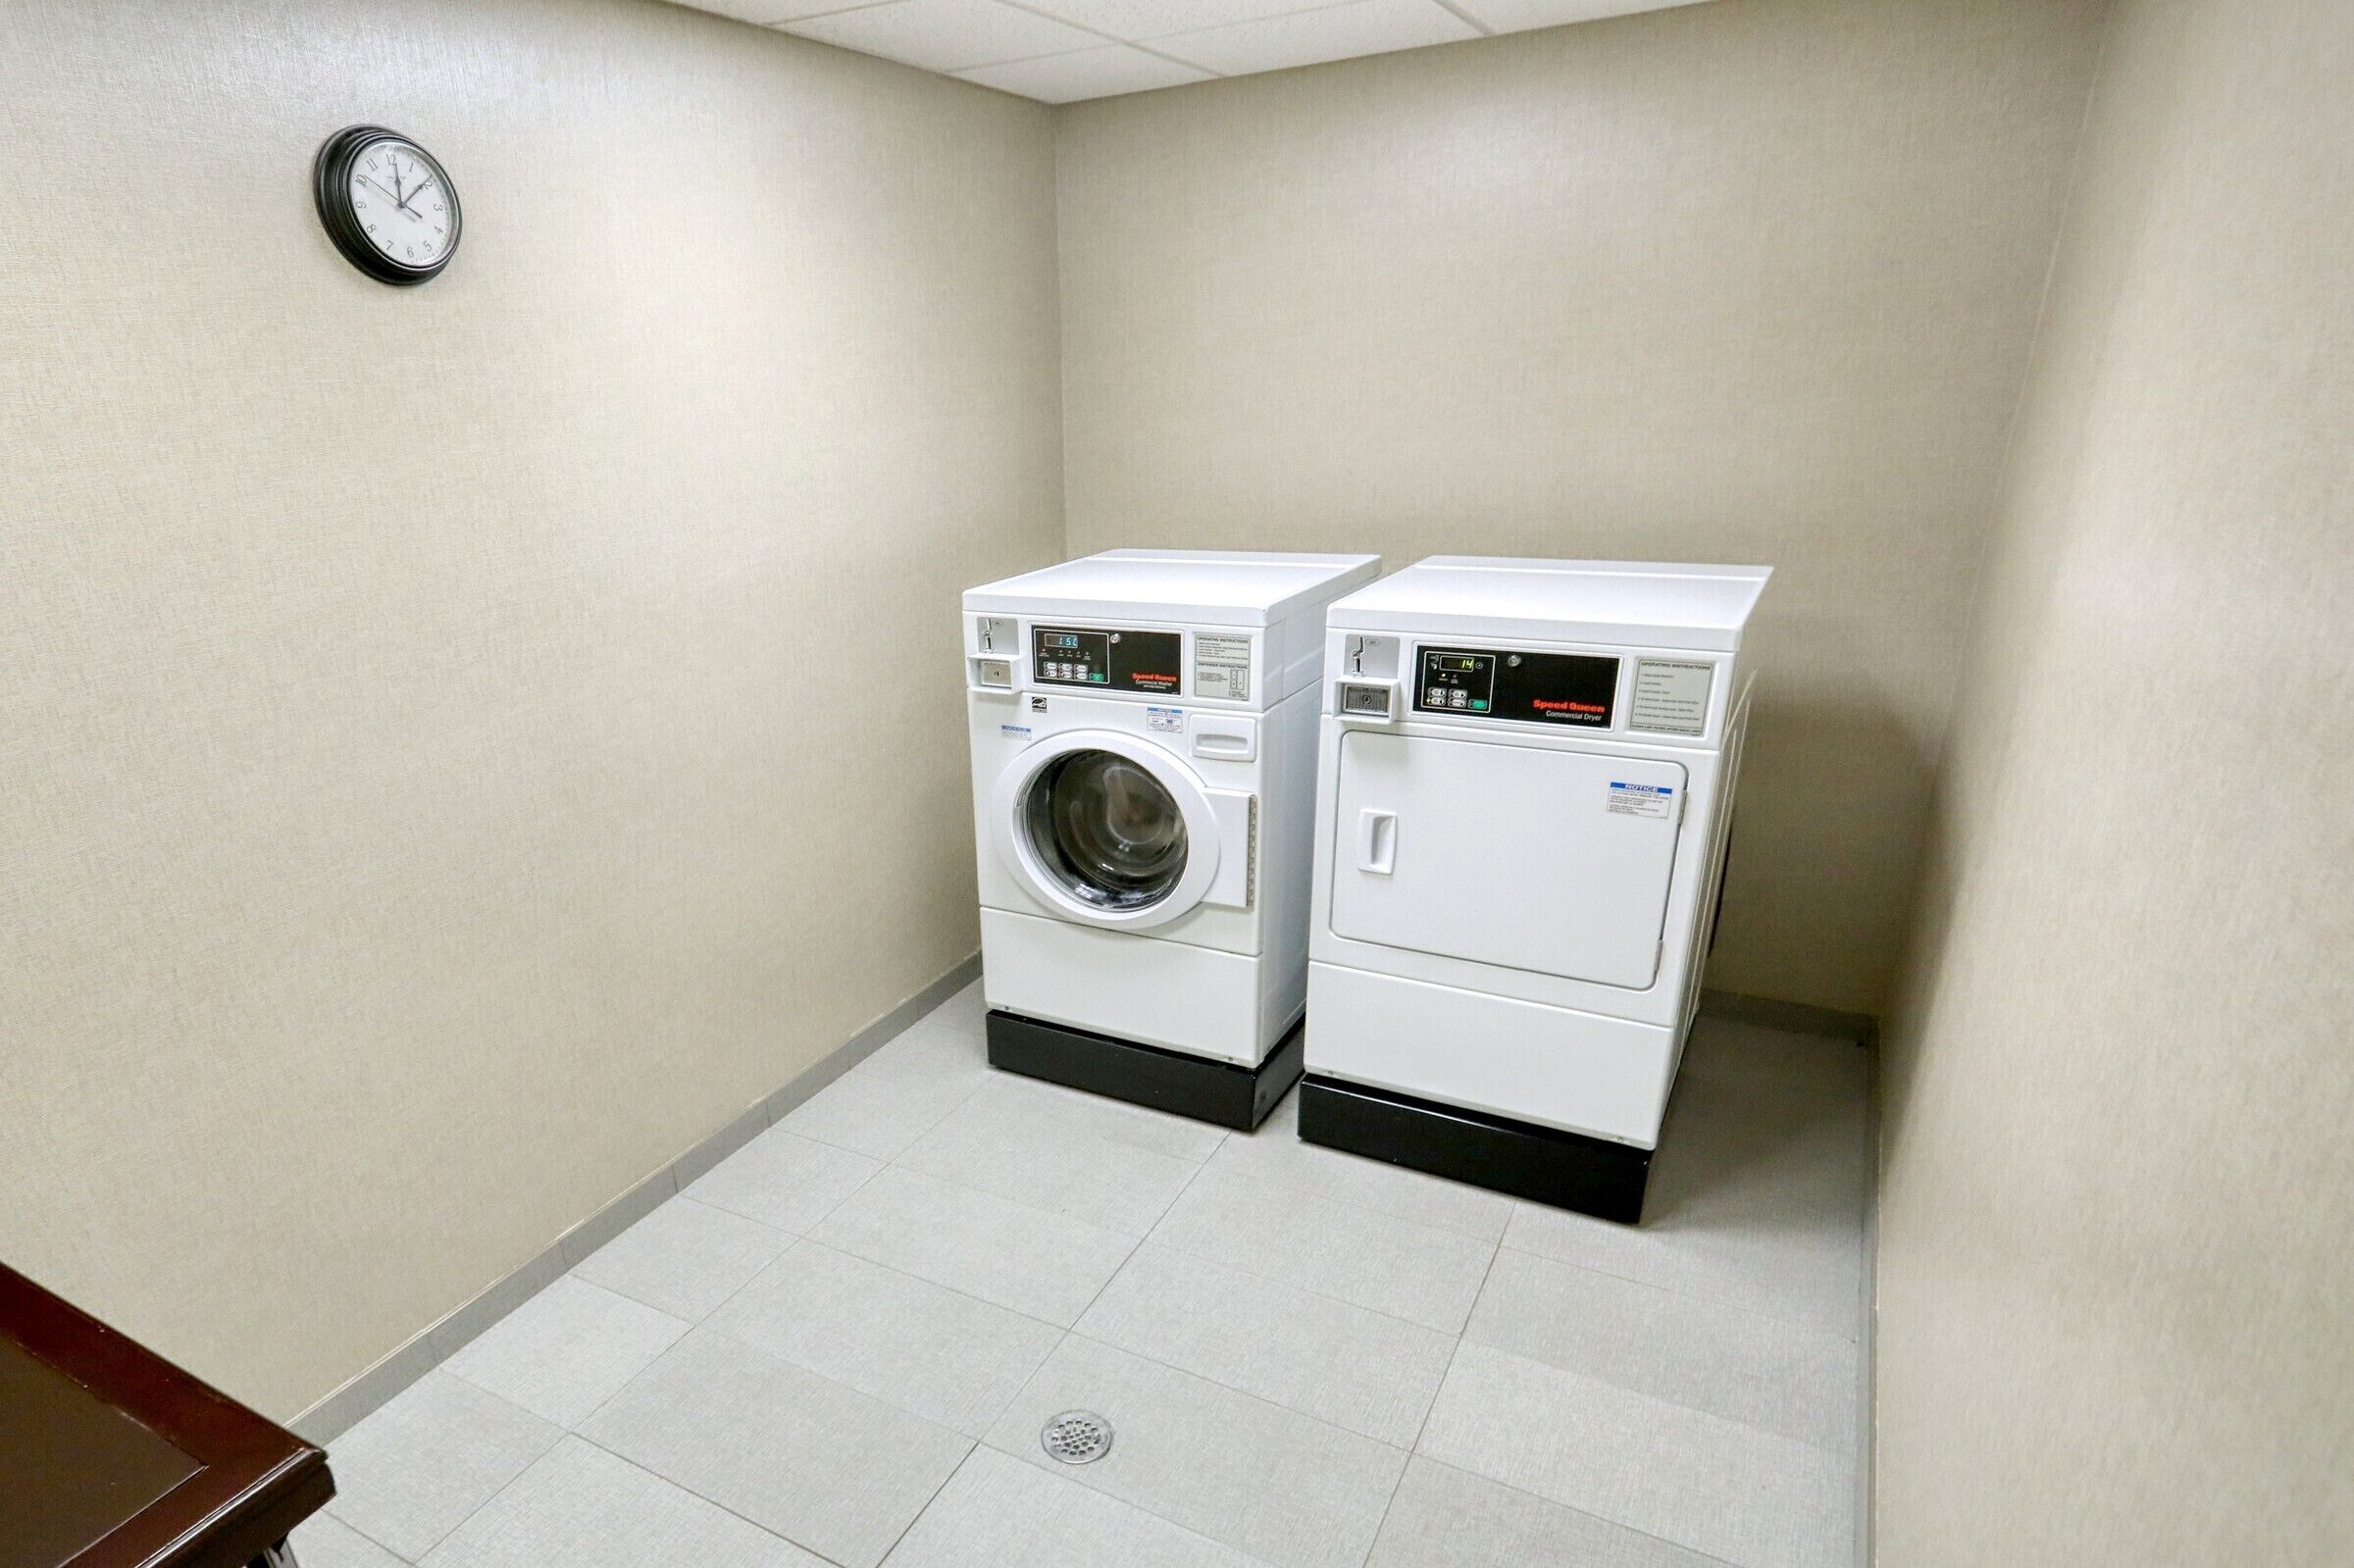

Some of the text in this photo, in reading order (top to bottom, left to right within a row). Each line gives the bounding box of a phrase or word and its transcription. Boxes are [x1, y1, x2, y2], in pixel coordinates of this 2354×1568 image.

[367, 158, 378, 171] 11
[386, 153, 397, 166] 12
[409, 162, 414, 173] 1
[356, 174, 367, 187] 10
[423, 179, 433, 189] 2
[367, 224, 377, 233] 8
[386, 240, 394, 251] 7
[423, 240, 432, 251] 5
[407, 247, 414, 258] 6
[1462, 659, 1474, 668] 14
[1533, 699, 1605, 713] Speed Queen
[1546, 710, 1583, 719] Commercial
[1626, 784, 1657, 793] NOTICE
